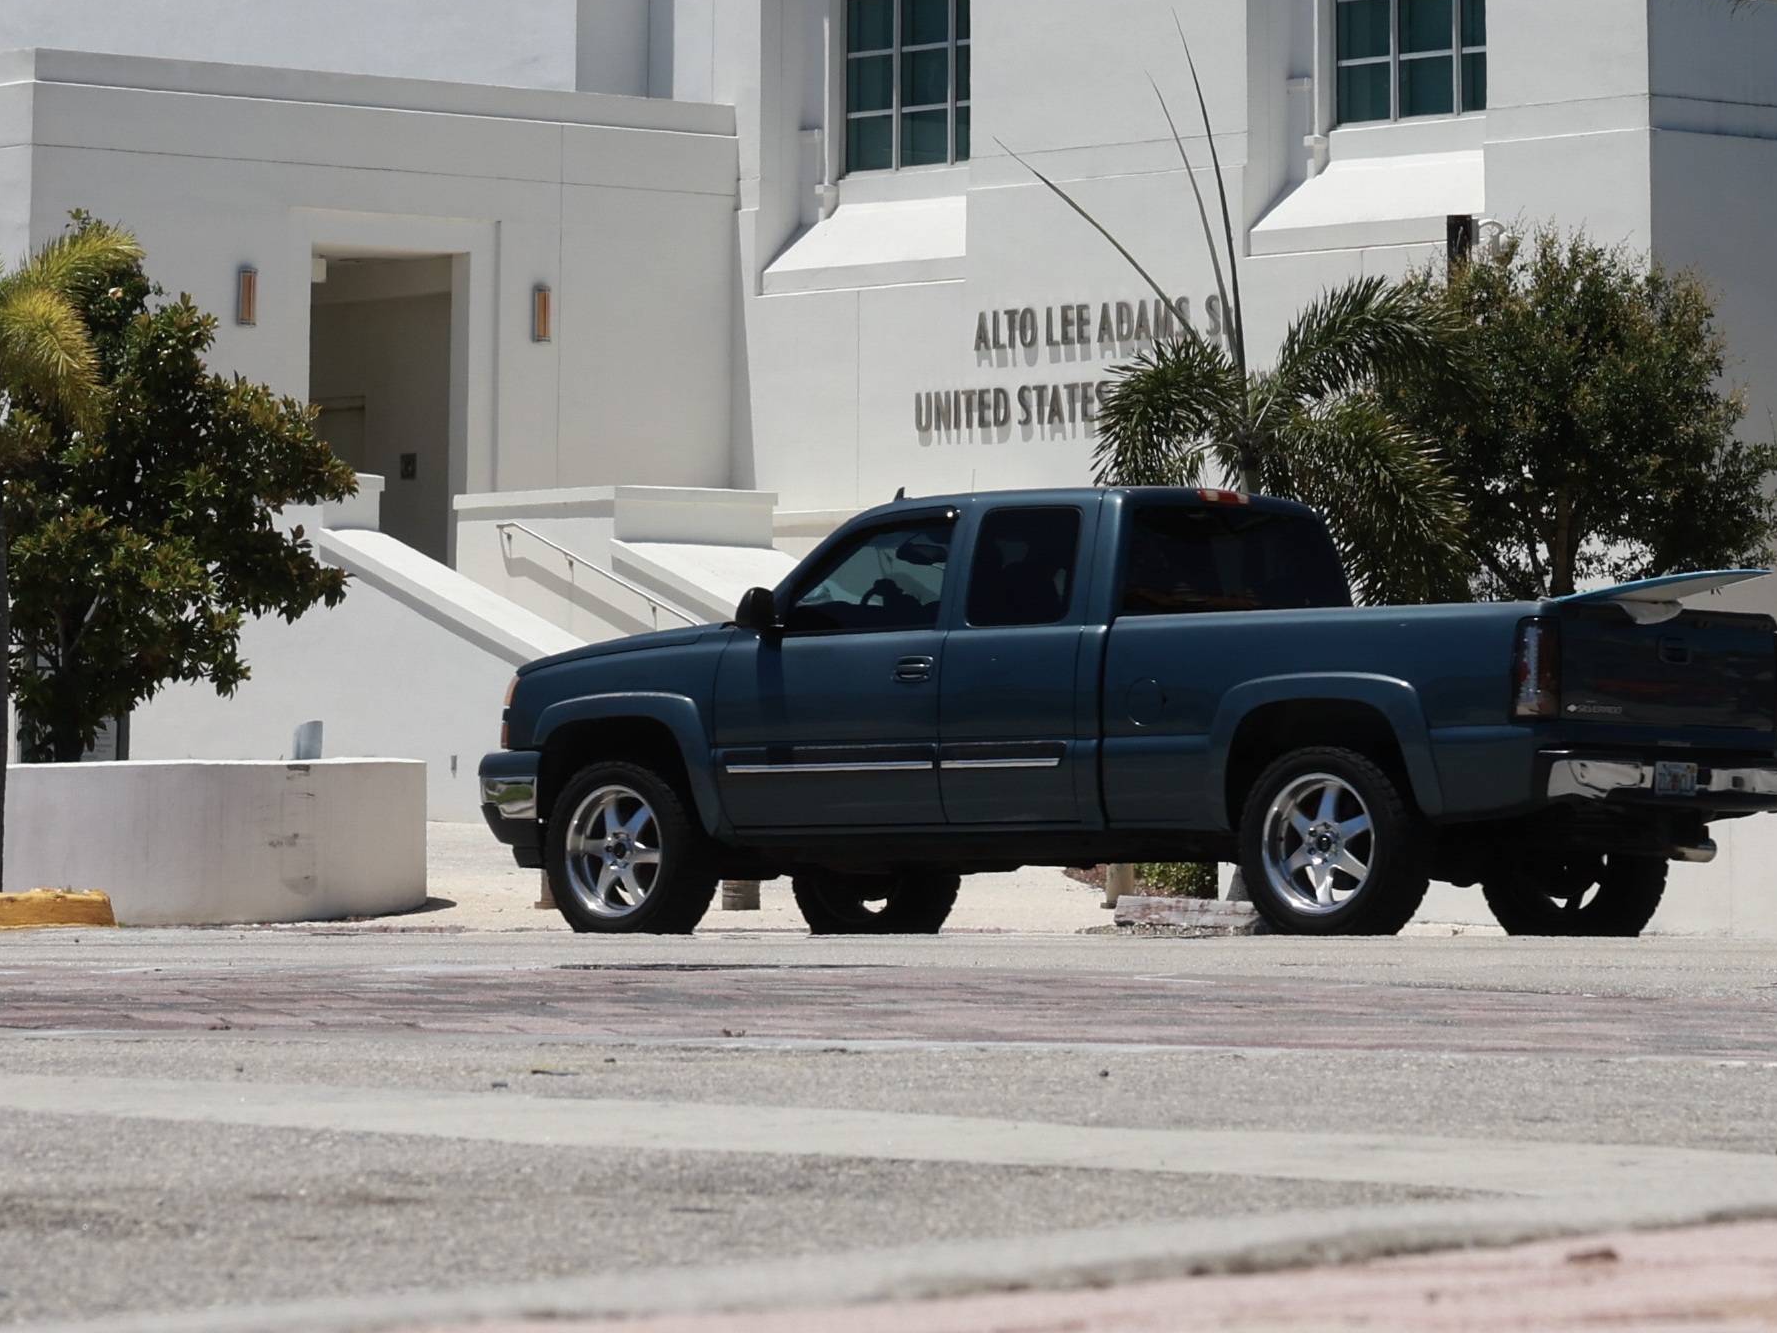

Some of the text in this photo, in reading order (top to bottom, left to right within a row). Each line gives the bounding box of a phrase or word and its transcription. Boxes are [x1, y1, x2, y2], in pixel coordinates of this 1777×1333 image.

[974, 307, 1038, 352] ALTO
[1045, 303, 1091, 347] LEE
[1097, 296, 1190, 343] ADAMS
[914, 386, 1011, 433] UNITED
